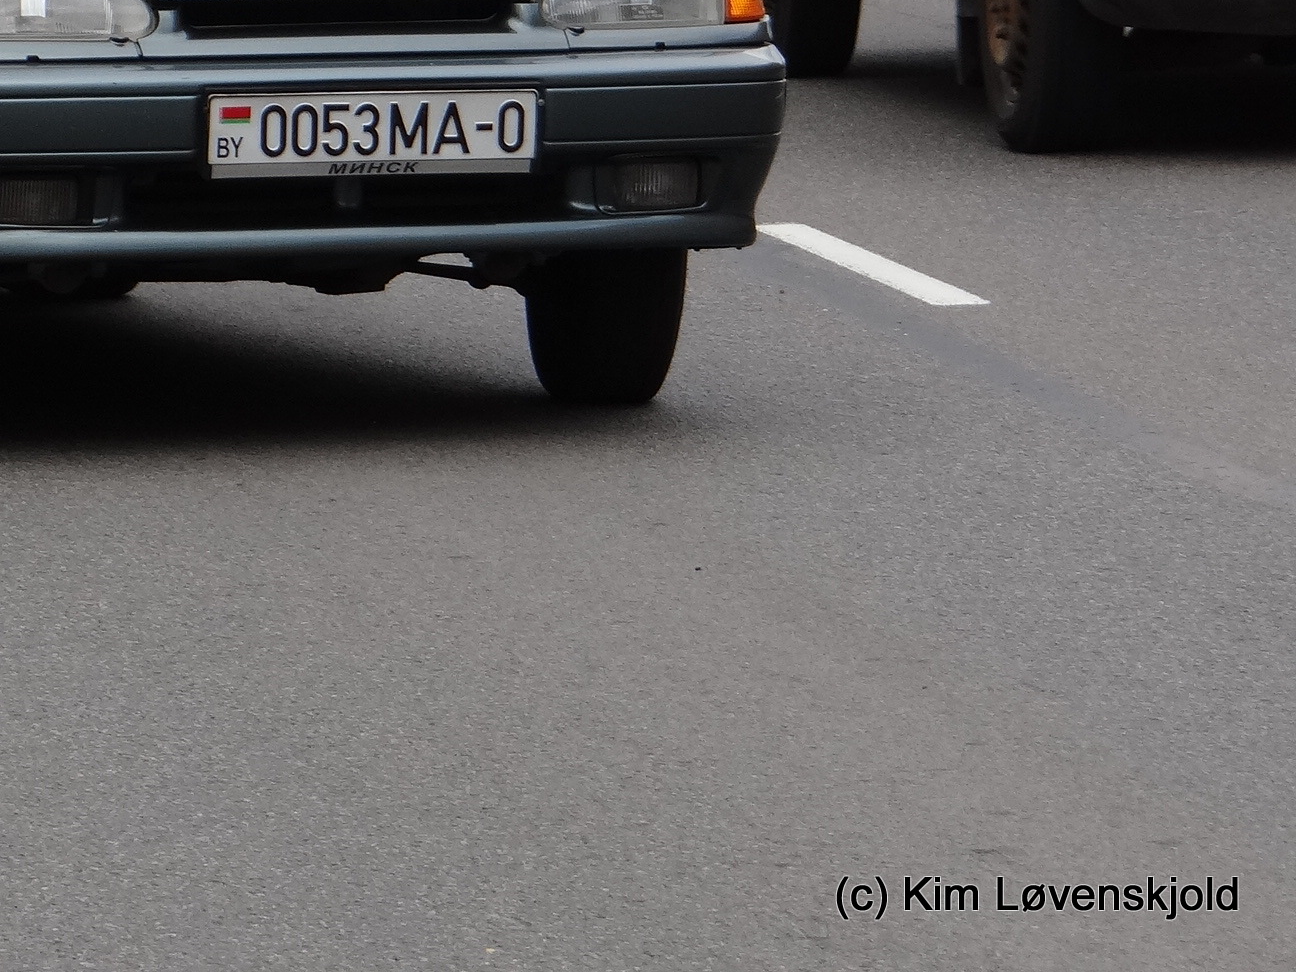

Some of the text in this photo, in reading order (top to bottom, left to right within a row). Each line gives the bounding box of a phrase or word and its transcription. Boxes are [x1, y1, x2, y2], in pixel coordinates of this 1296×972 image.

[259, 99, 525, 157] 0053MA-0
[216, 137, 244, 158] BY
[328, 161, 420, 175] МИНСК
